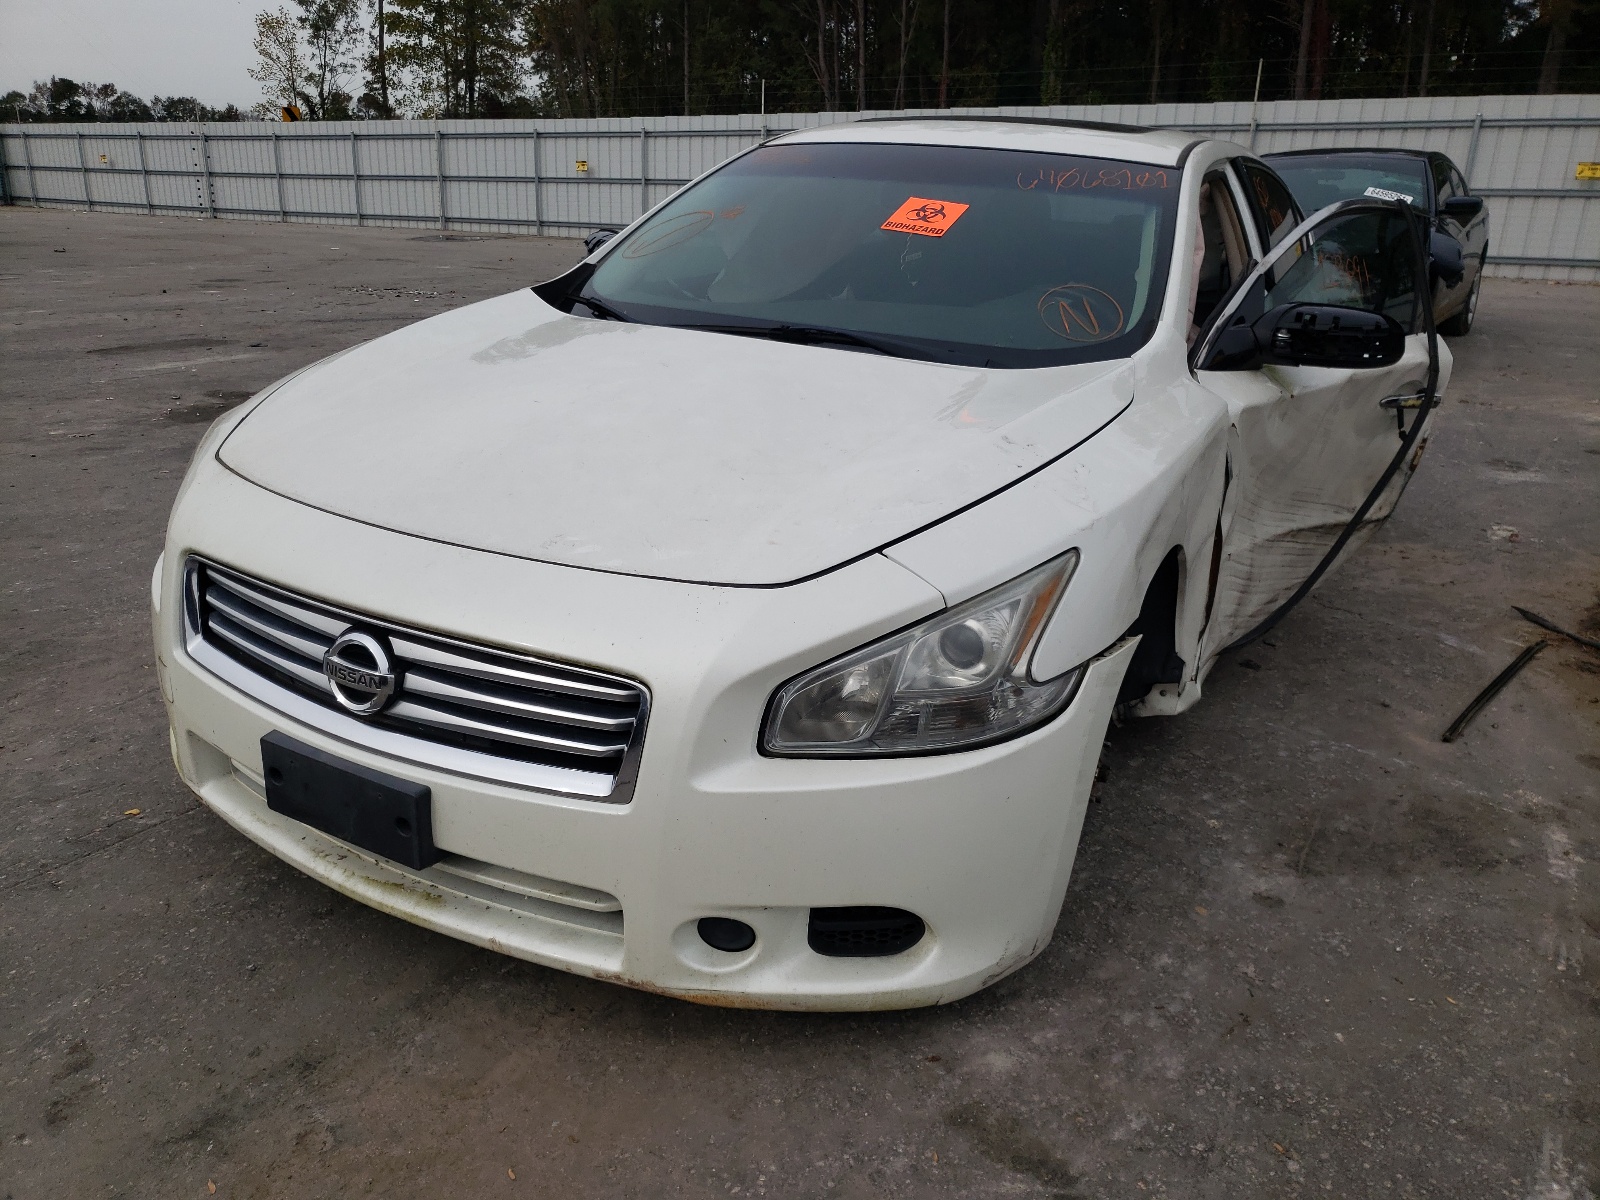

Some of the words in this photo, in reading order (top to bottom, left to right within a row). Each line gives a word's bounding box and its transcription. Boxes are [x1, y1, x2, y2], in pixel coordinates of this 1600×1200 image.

[884, 220, 945, 235] BIOHAZARD
[1059, 296, 1100, 335] N
[326, 661, 382, 690] NISSAN
